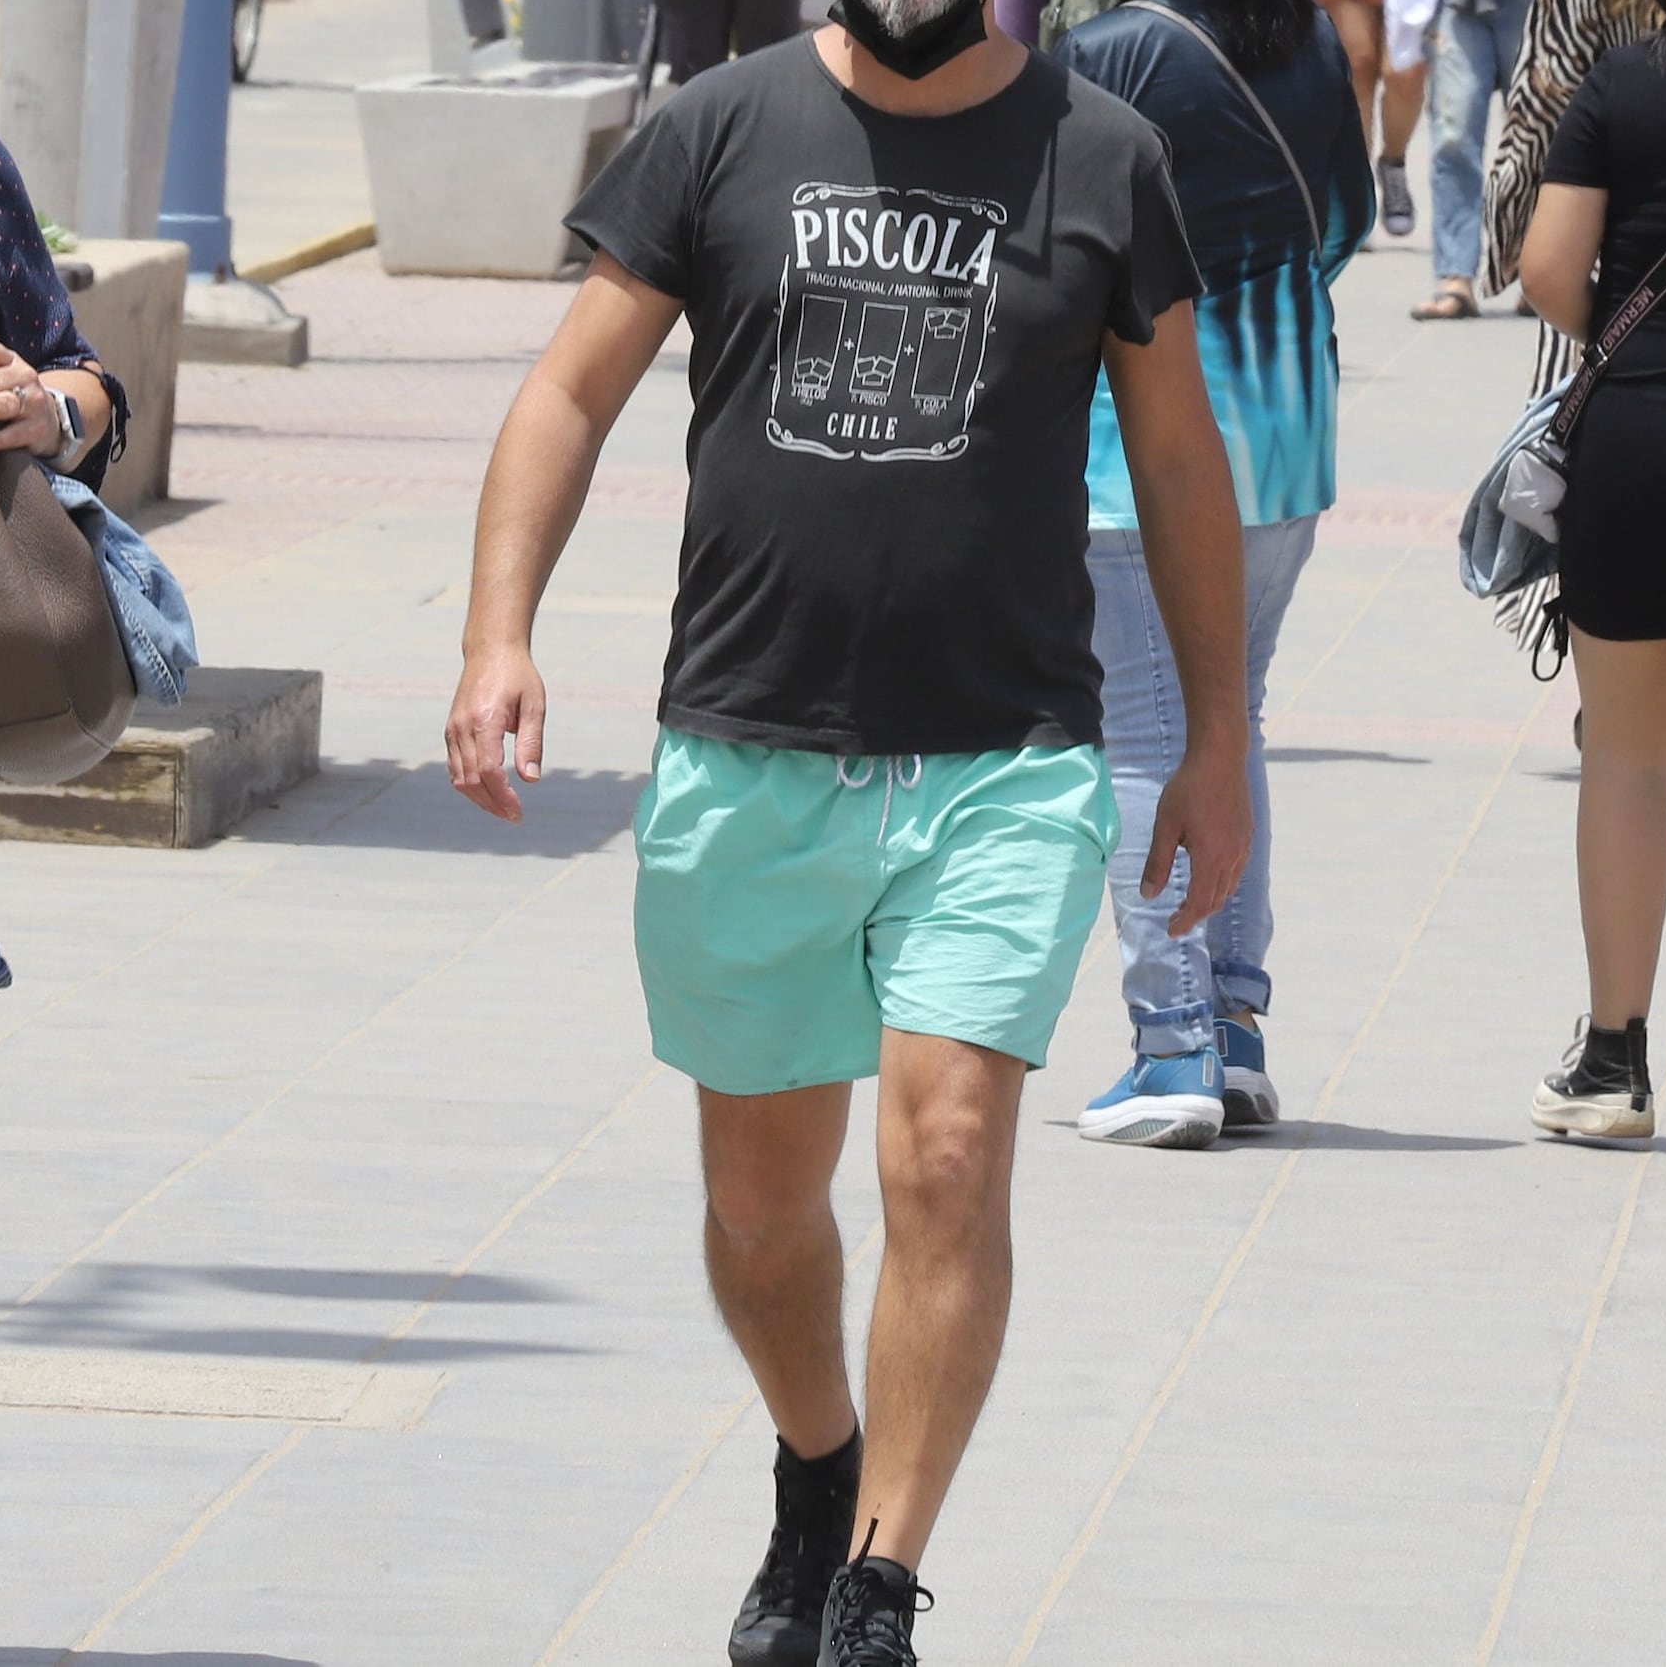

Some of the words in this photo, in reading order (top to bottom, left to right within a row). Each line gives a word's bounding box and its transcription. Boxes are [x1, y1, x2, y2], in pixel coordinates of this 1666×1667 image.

[791, 207, 997, 286] PISCOLA
[805, 271, 836, 287] TRAGO
[838, 277, 886, 296] NACIONAL
[894, 284, 941, 299] NATIONAL
[1602, 285, 1655, 350] MERMAID
[826, 412, 899, 441] CHILE
